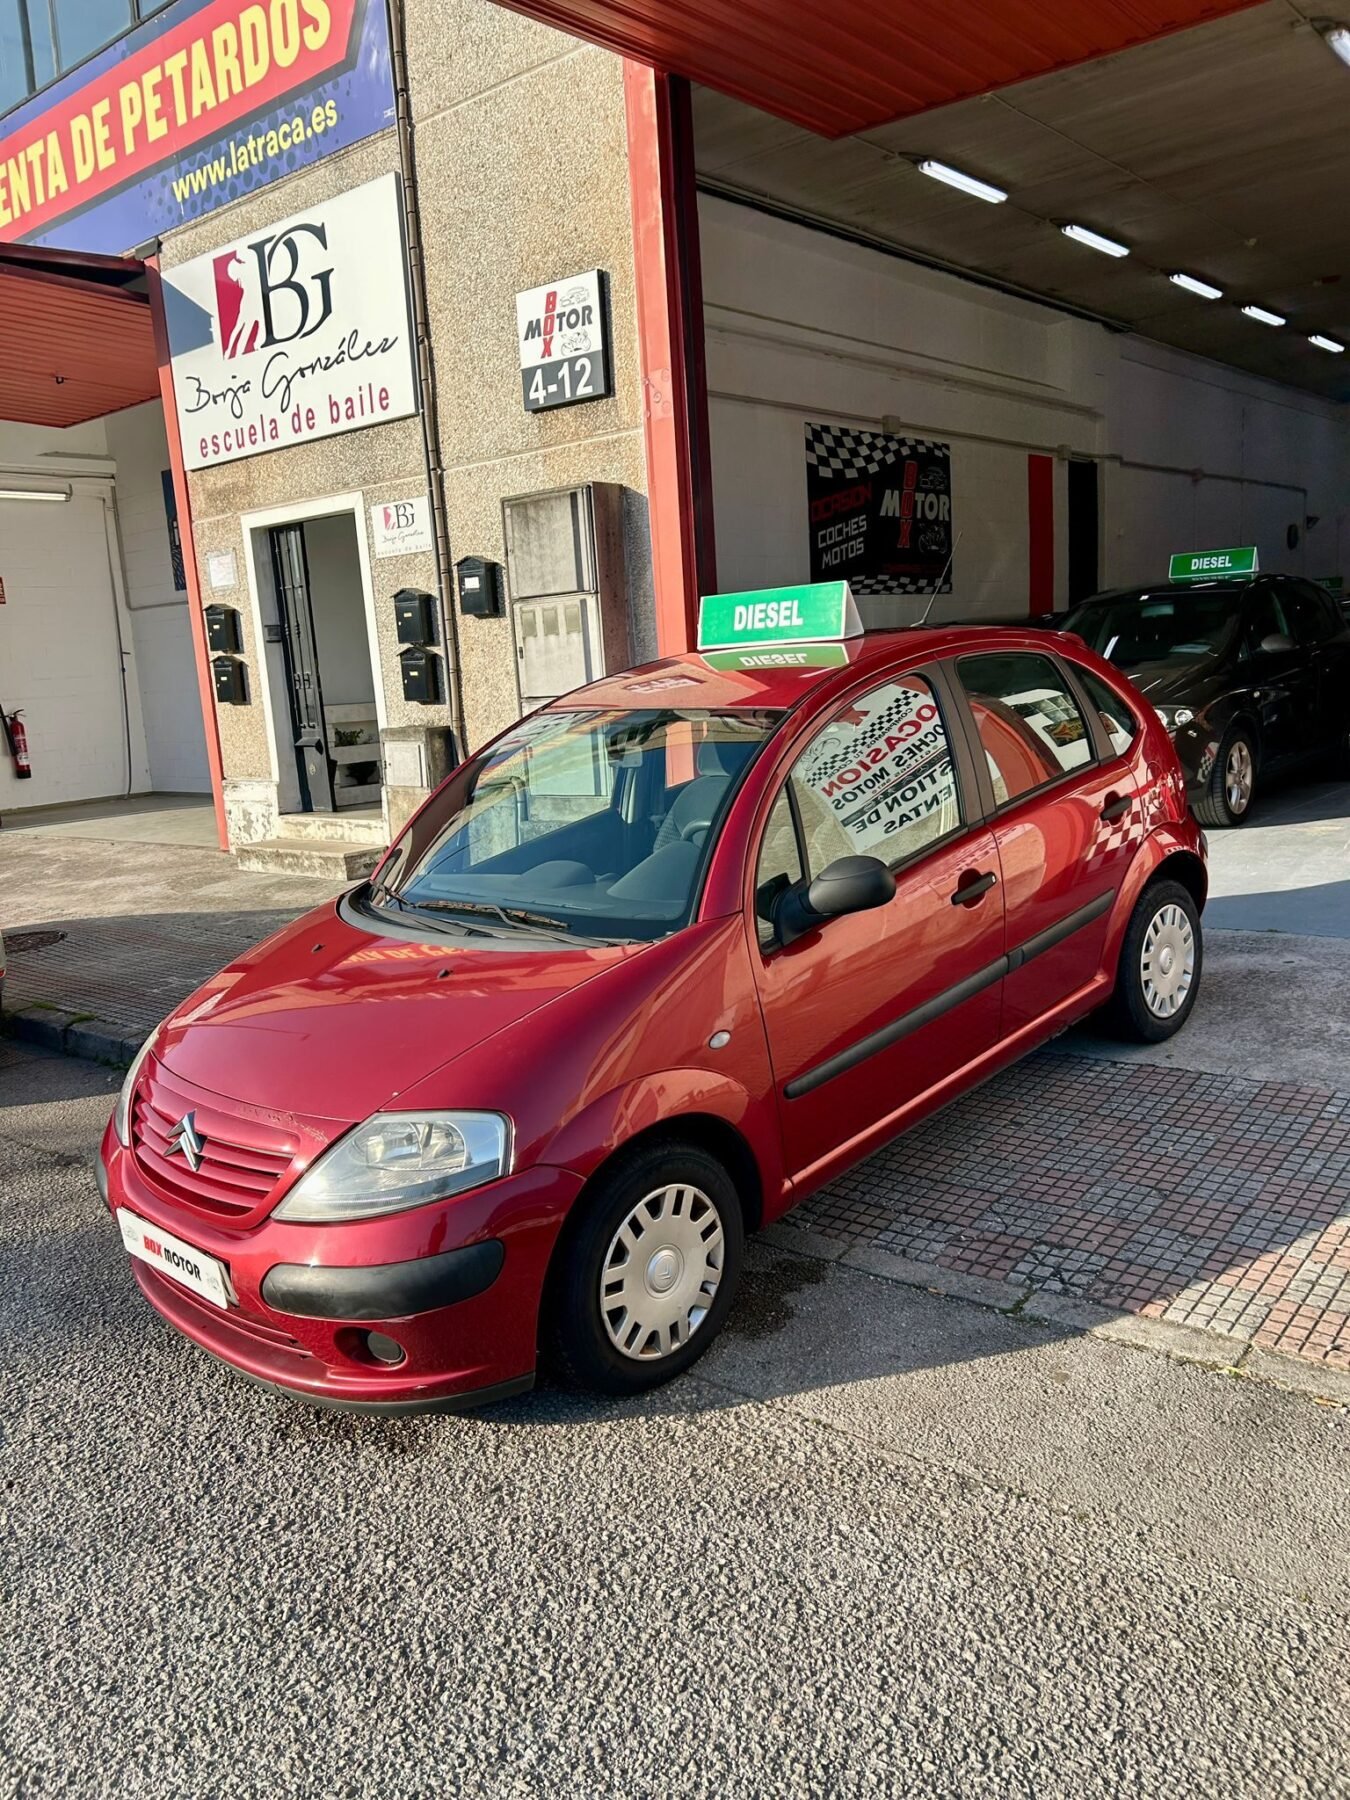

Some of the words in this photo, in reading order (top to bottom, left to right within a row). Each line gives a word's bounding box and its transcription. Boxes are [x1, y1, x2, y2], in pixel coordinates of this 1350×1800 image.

[0, 130, 68, 228] ENTA
[70, 97, 116, 184] DE
[119, 0, 331, 156] PETARDOS
[172, 99, 338, 203] www.latraca.es
[247, 222, 334, 348] BG
[524, 305, 593, 341] MOTOR
[541, 291, 557, 359] BOX
[185, 375, 250, 418] Borja
[262, 329, 398, 413] González
[529, 357, 593, 404] 4-12
[200, 414, 278, 458] escuela
[292, 404, 315, 434] de
[329, 383, 389, 424] baile
[880, 489, 950, 521] MOTOR
[818, 515, 867, 548] COCHES
[822, 537, 864, 569] MOTOS
[1191, 556, 1232, 570] DIESEL
[733, 599, 804, 631] DIESEL
[143, 1235, 162, 1257] BOX
[164, 1248, 201, 1281] MOTOR
